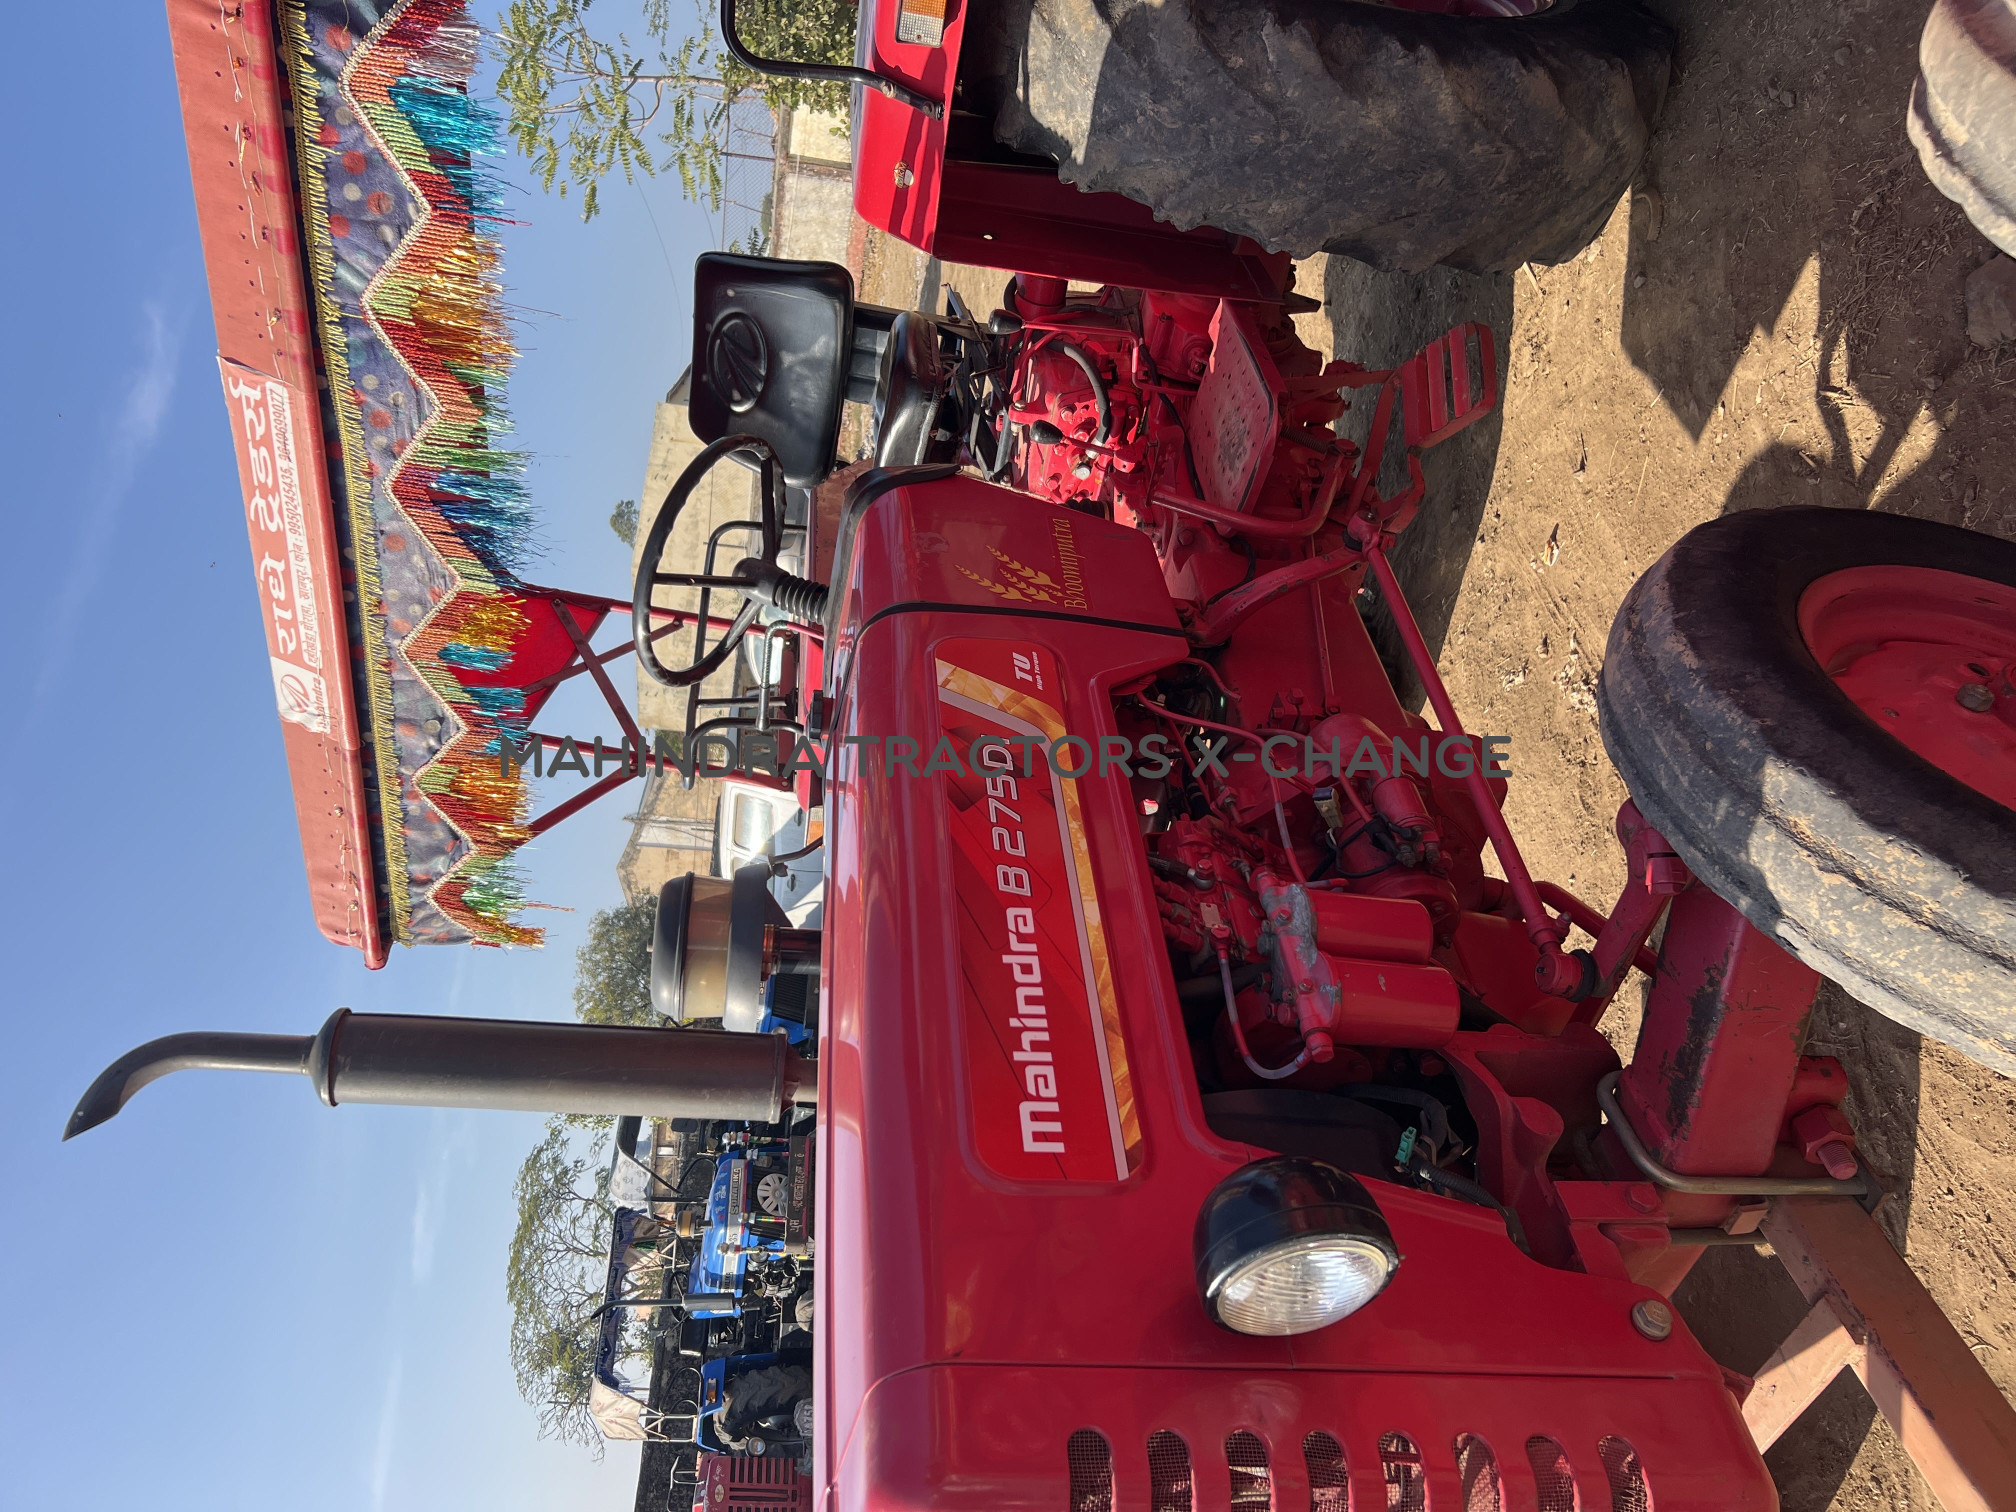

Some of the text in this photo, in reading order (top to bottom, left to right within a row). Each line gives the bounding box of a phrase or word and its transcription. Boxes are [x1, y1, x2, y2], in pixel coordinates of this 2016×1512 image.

[228, 376, 297, 654] राधे ट्रेडर्स
[1052, 518, 1087, 610] Bhoomiputra
[1012, 652, 1032, 682] TU
[1032, 652, 1040, 674] Torque
[996, 864, 1032, 896] B
[1002, 907, 1066, 1153] Mahindra
[730, 1166, 742, 1216] SONALIKA
